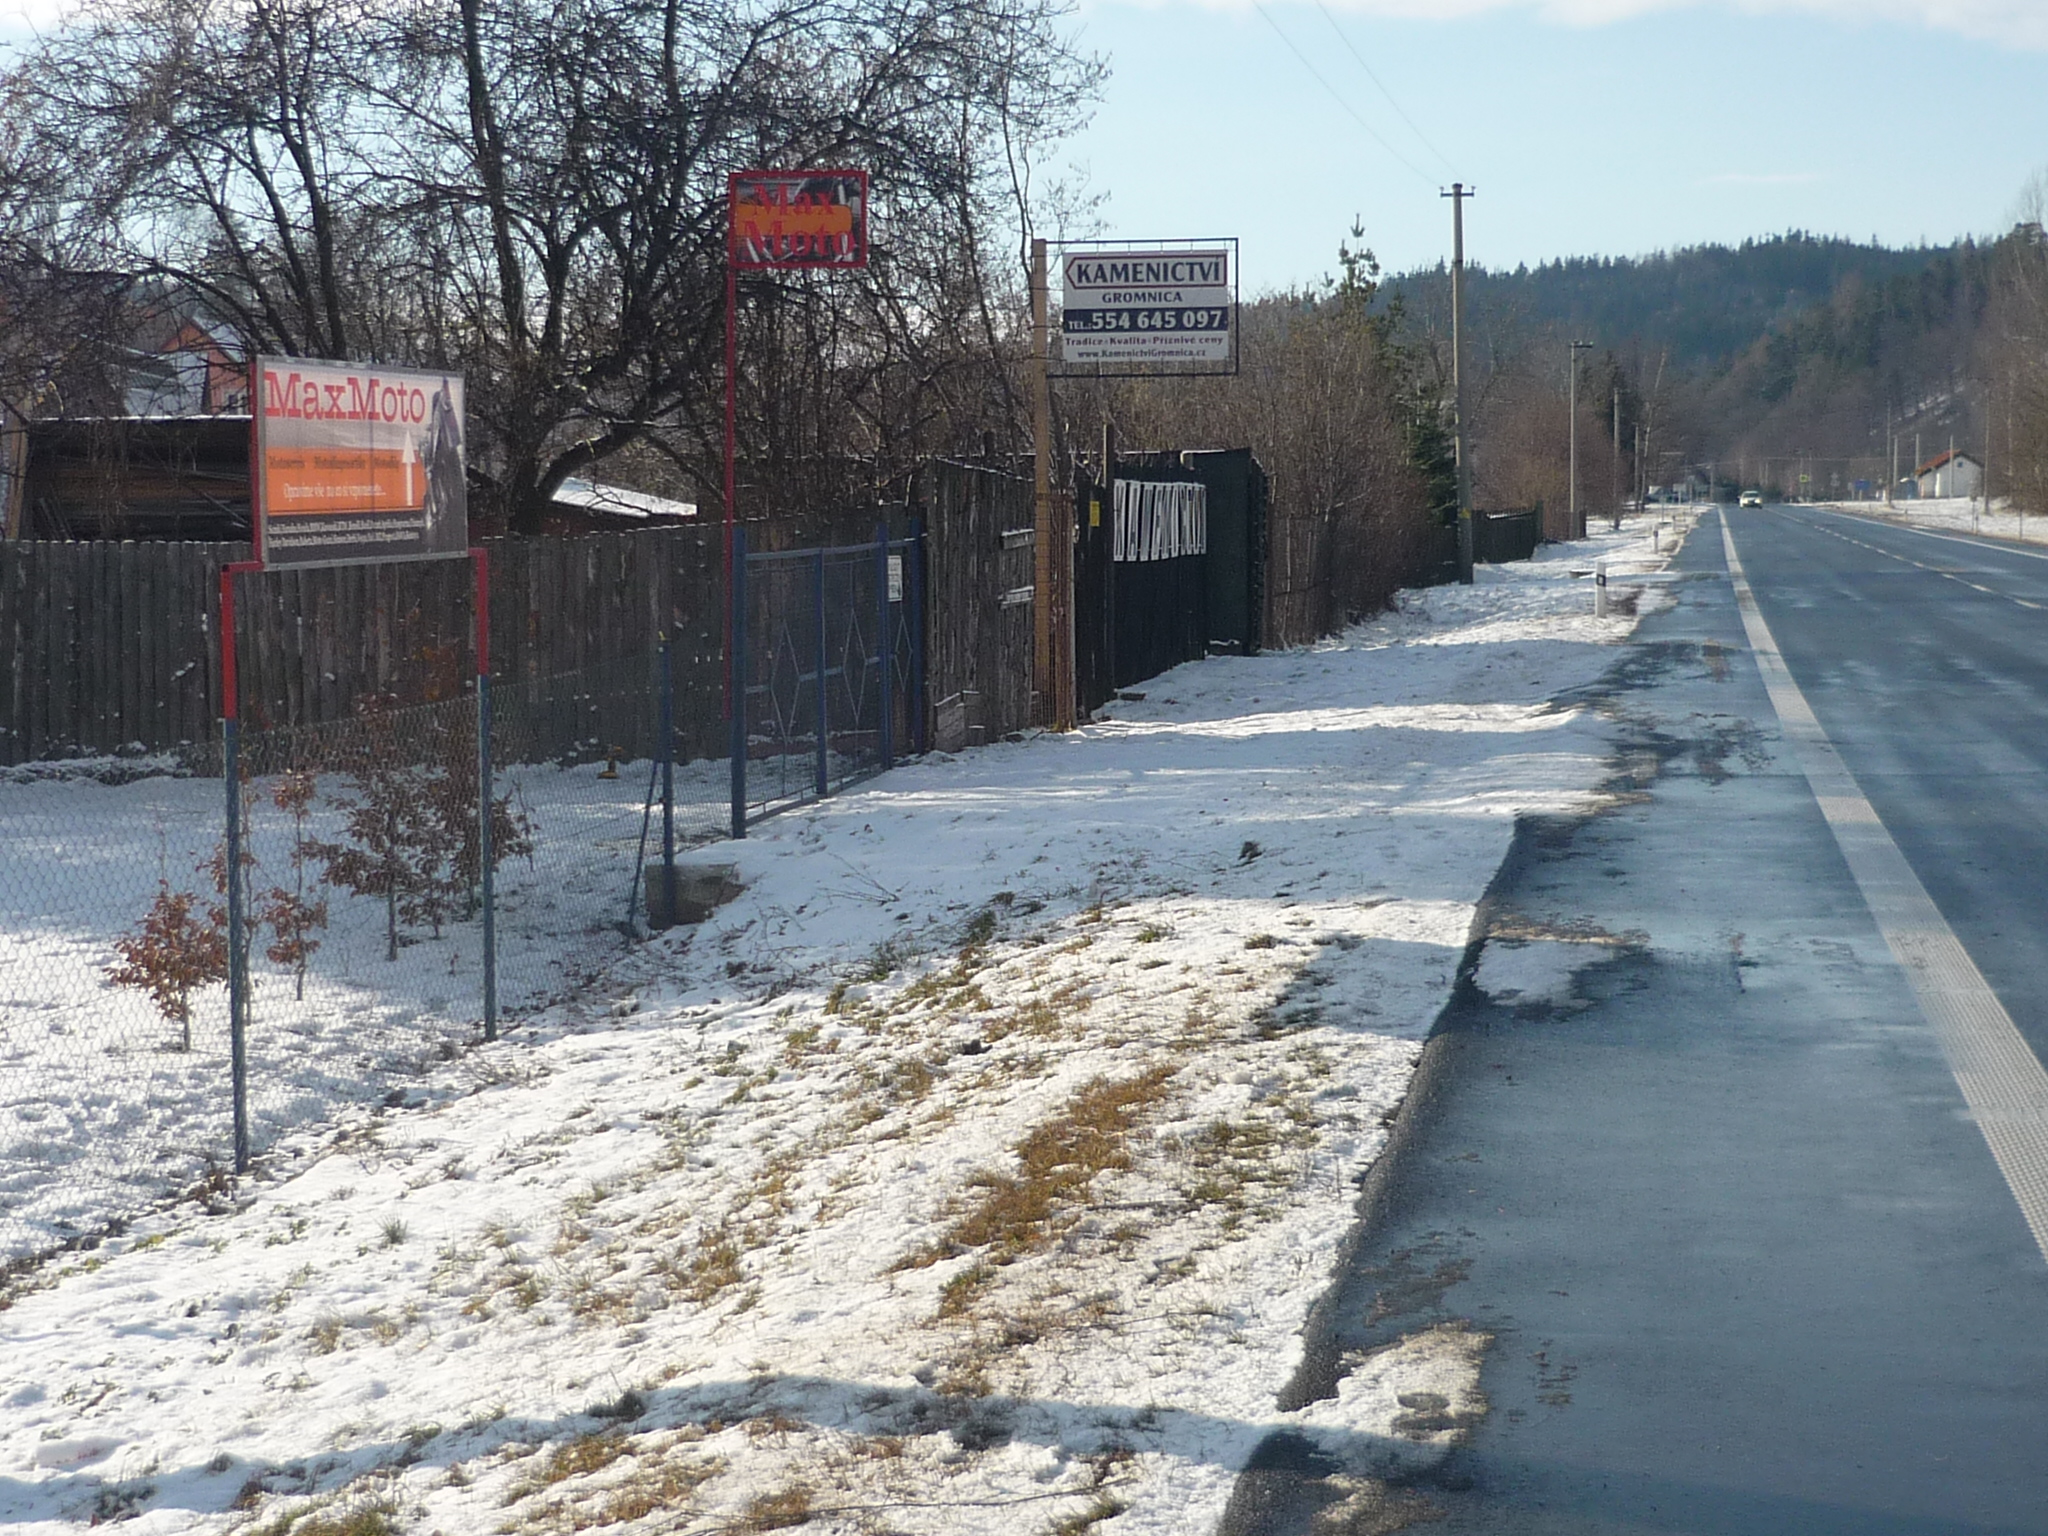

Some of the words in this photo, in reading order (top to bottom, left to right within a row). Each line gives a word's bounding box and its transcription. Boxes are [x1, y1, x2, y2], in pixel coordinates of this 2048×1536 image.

[753, 183, 835, 215] Max
[744, 220, 856, 256] Moto
[1102, 292, 1183, 304] GROMNICA
[1092, 312, 1130, 329] 554
[1137, 311, 1176, 329] 645
[1182, 310, 1222, 328] 097
[1066, 337, 1104, 346] Tradice
[1109, 336, 1147, 345] Kvalita
[1199, 337, 1223, 346] ceny
[264, 371, 426, 424] MaxMoto
